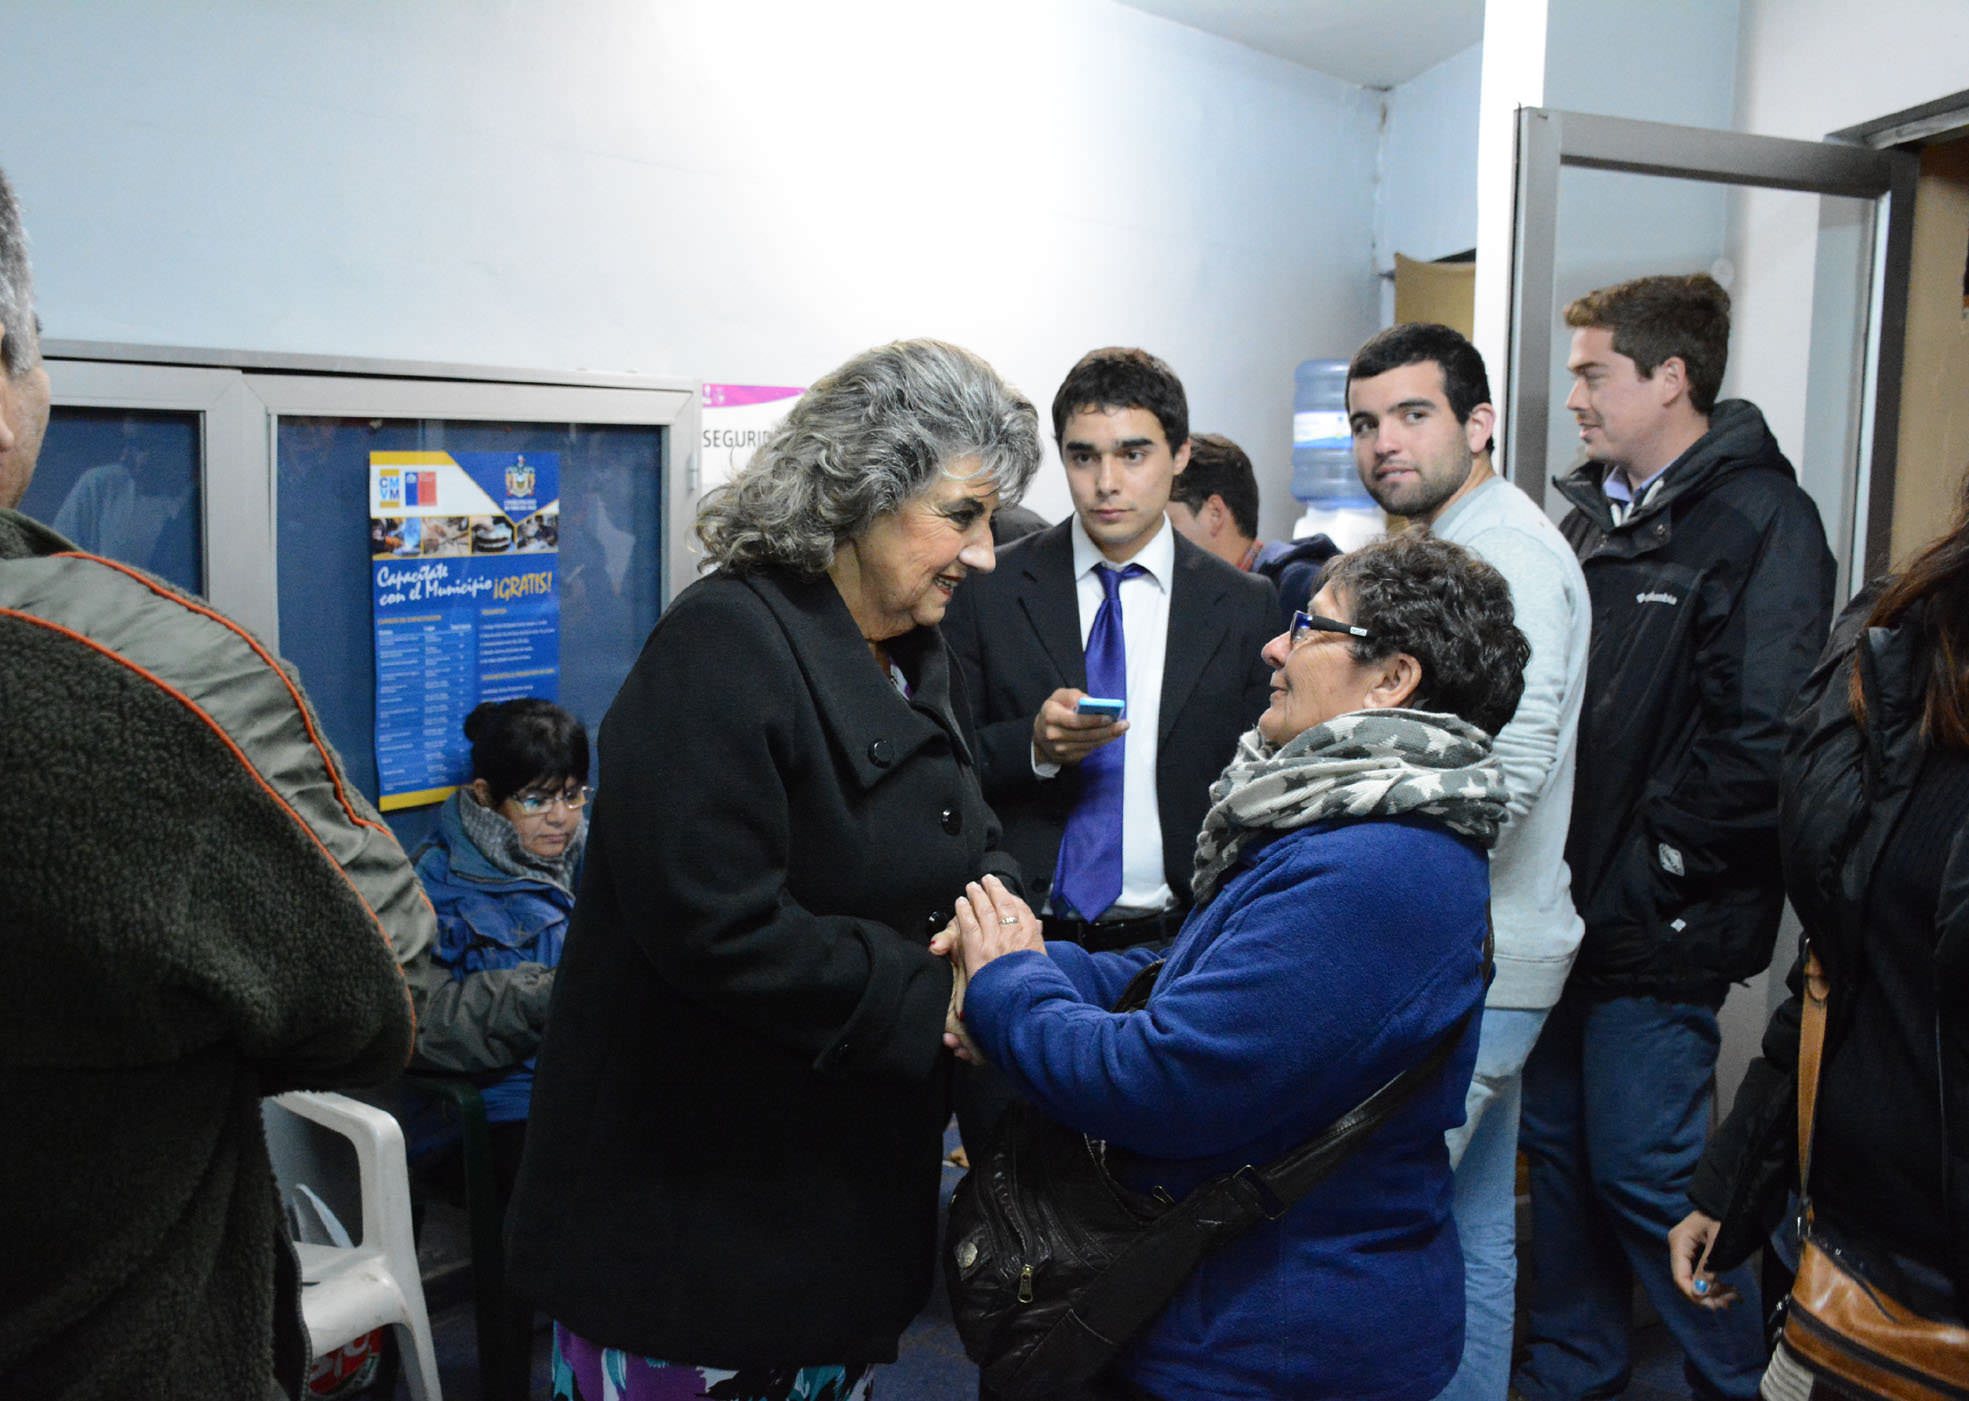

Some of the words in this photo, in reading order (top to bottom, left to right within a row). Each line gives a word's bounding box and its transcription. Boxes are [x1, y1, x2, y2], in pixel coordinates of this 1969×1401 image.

[379, 592, 406, 606] con
[409, 581, 422, 600] el
[425, 576, 493, 598] Municipio
[493, 571, 552, 602] ¡GRATIS!
